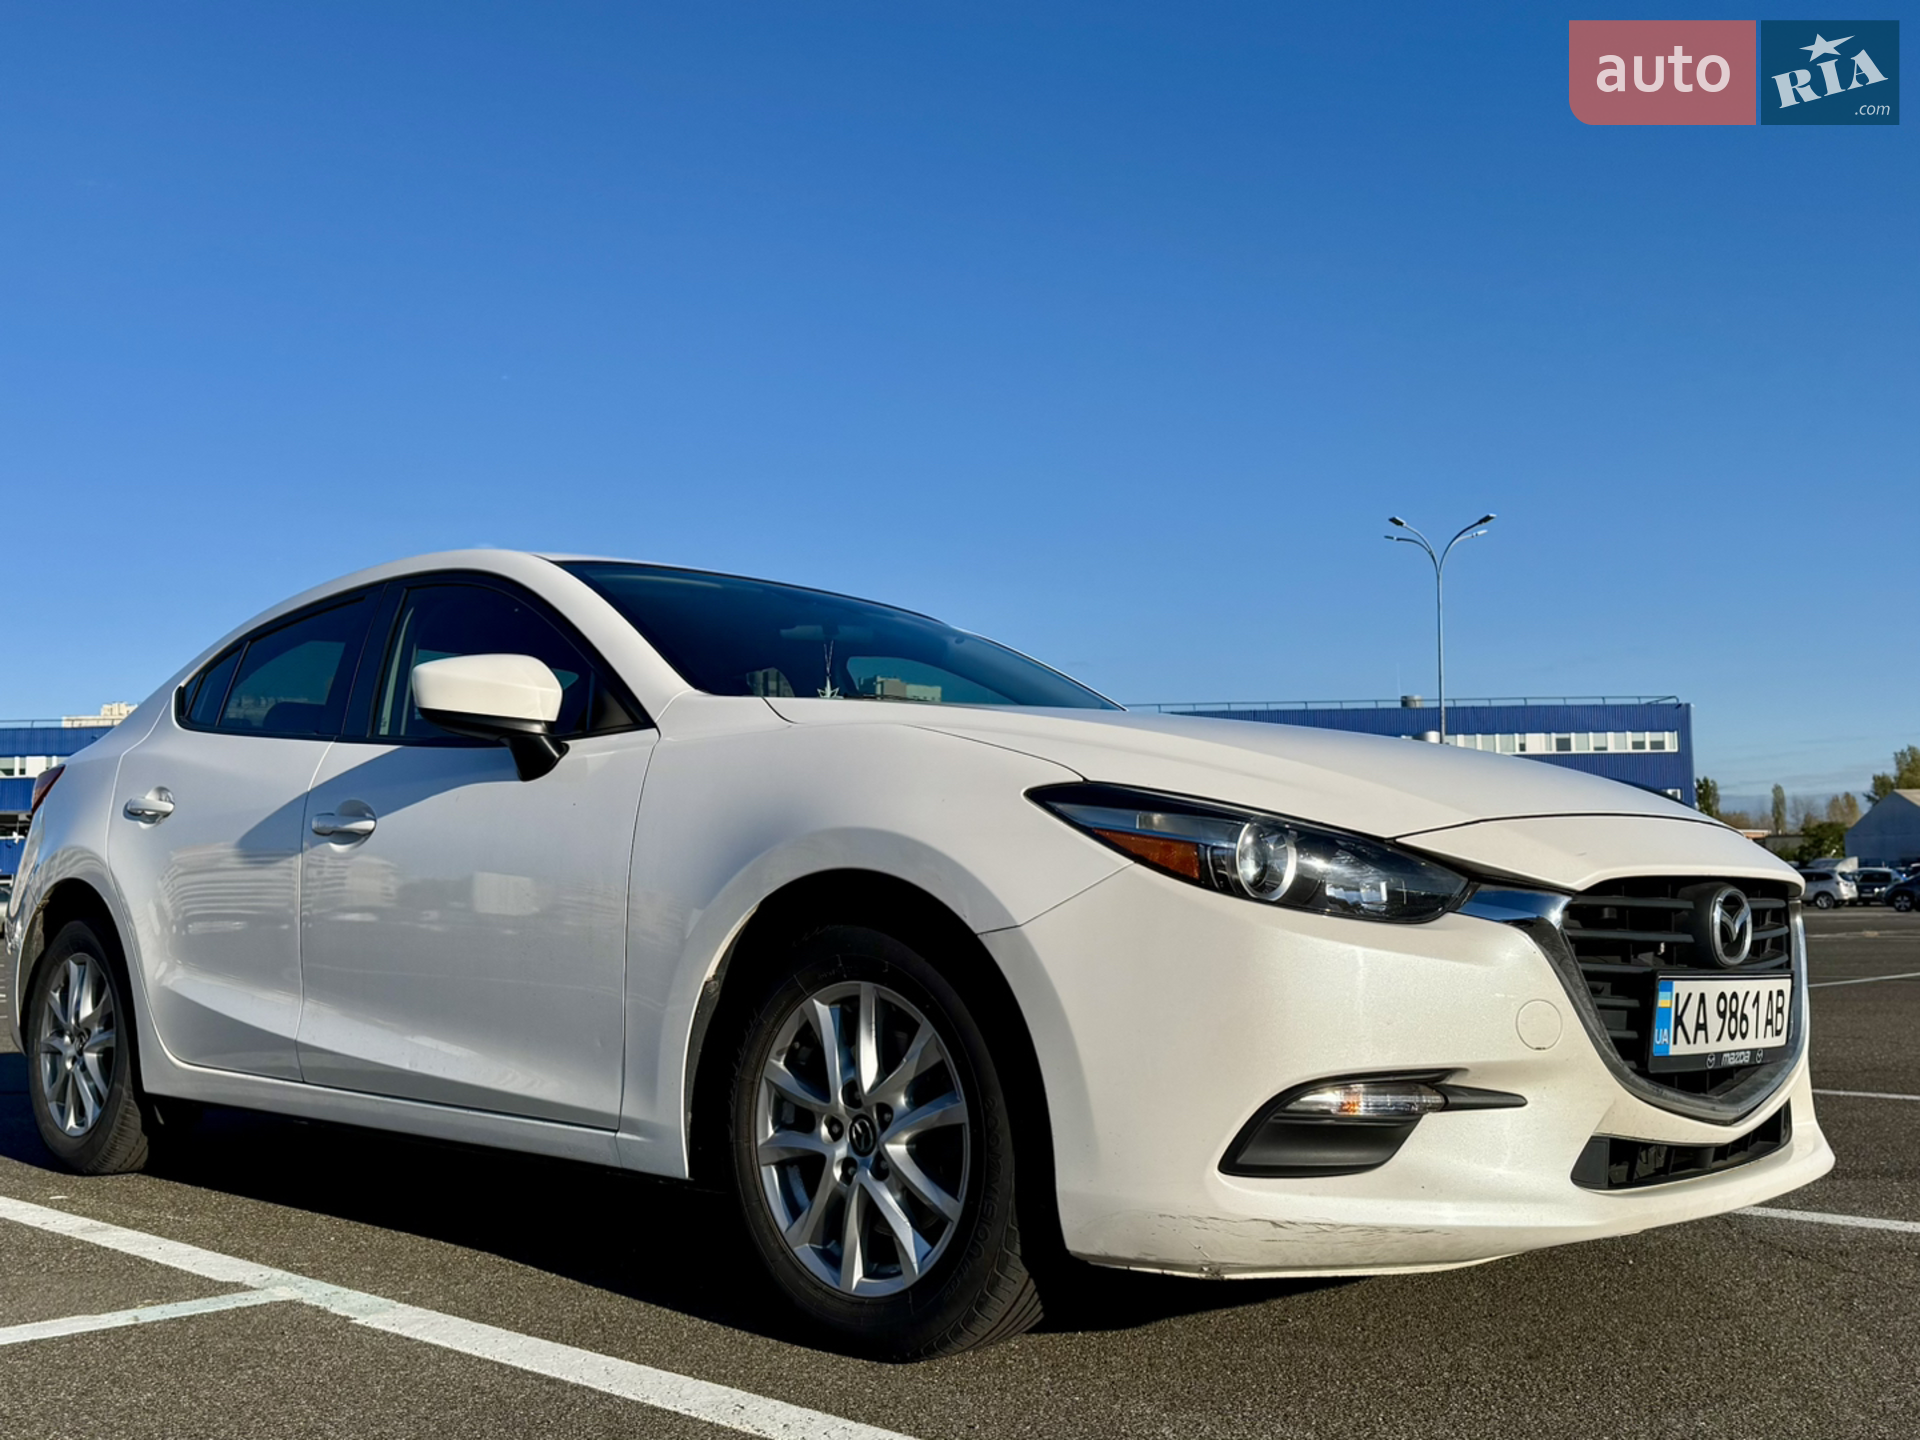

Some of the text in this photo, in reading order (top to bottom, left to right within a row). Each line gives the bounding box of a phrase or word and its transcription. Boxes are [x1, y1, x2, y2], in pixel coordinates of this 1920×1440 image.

[1673, 988, 1785, 1045] KA 9861 AB
[1655, 1028, 1670, 1045] UA
